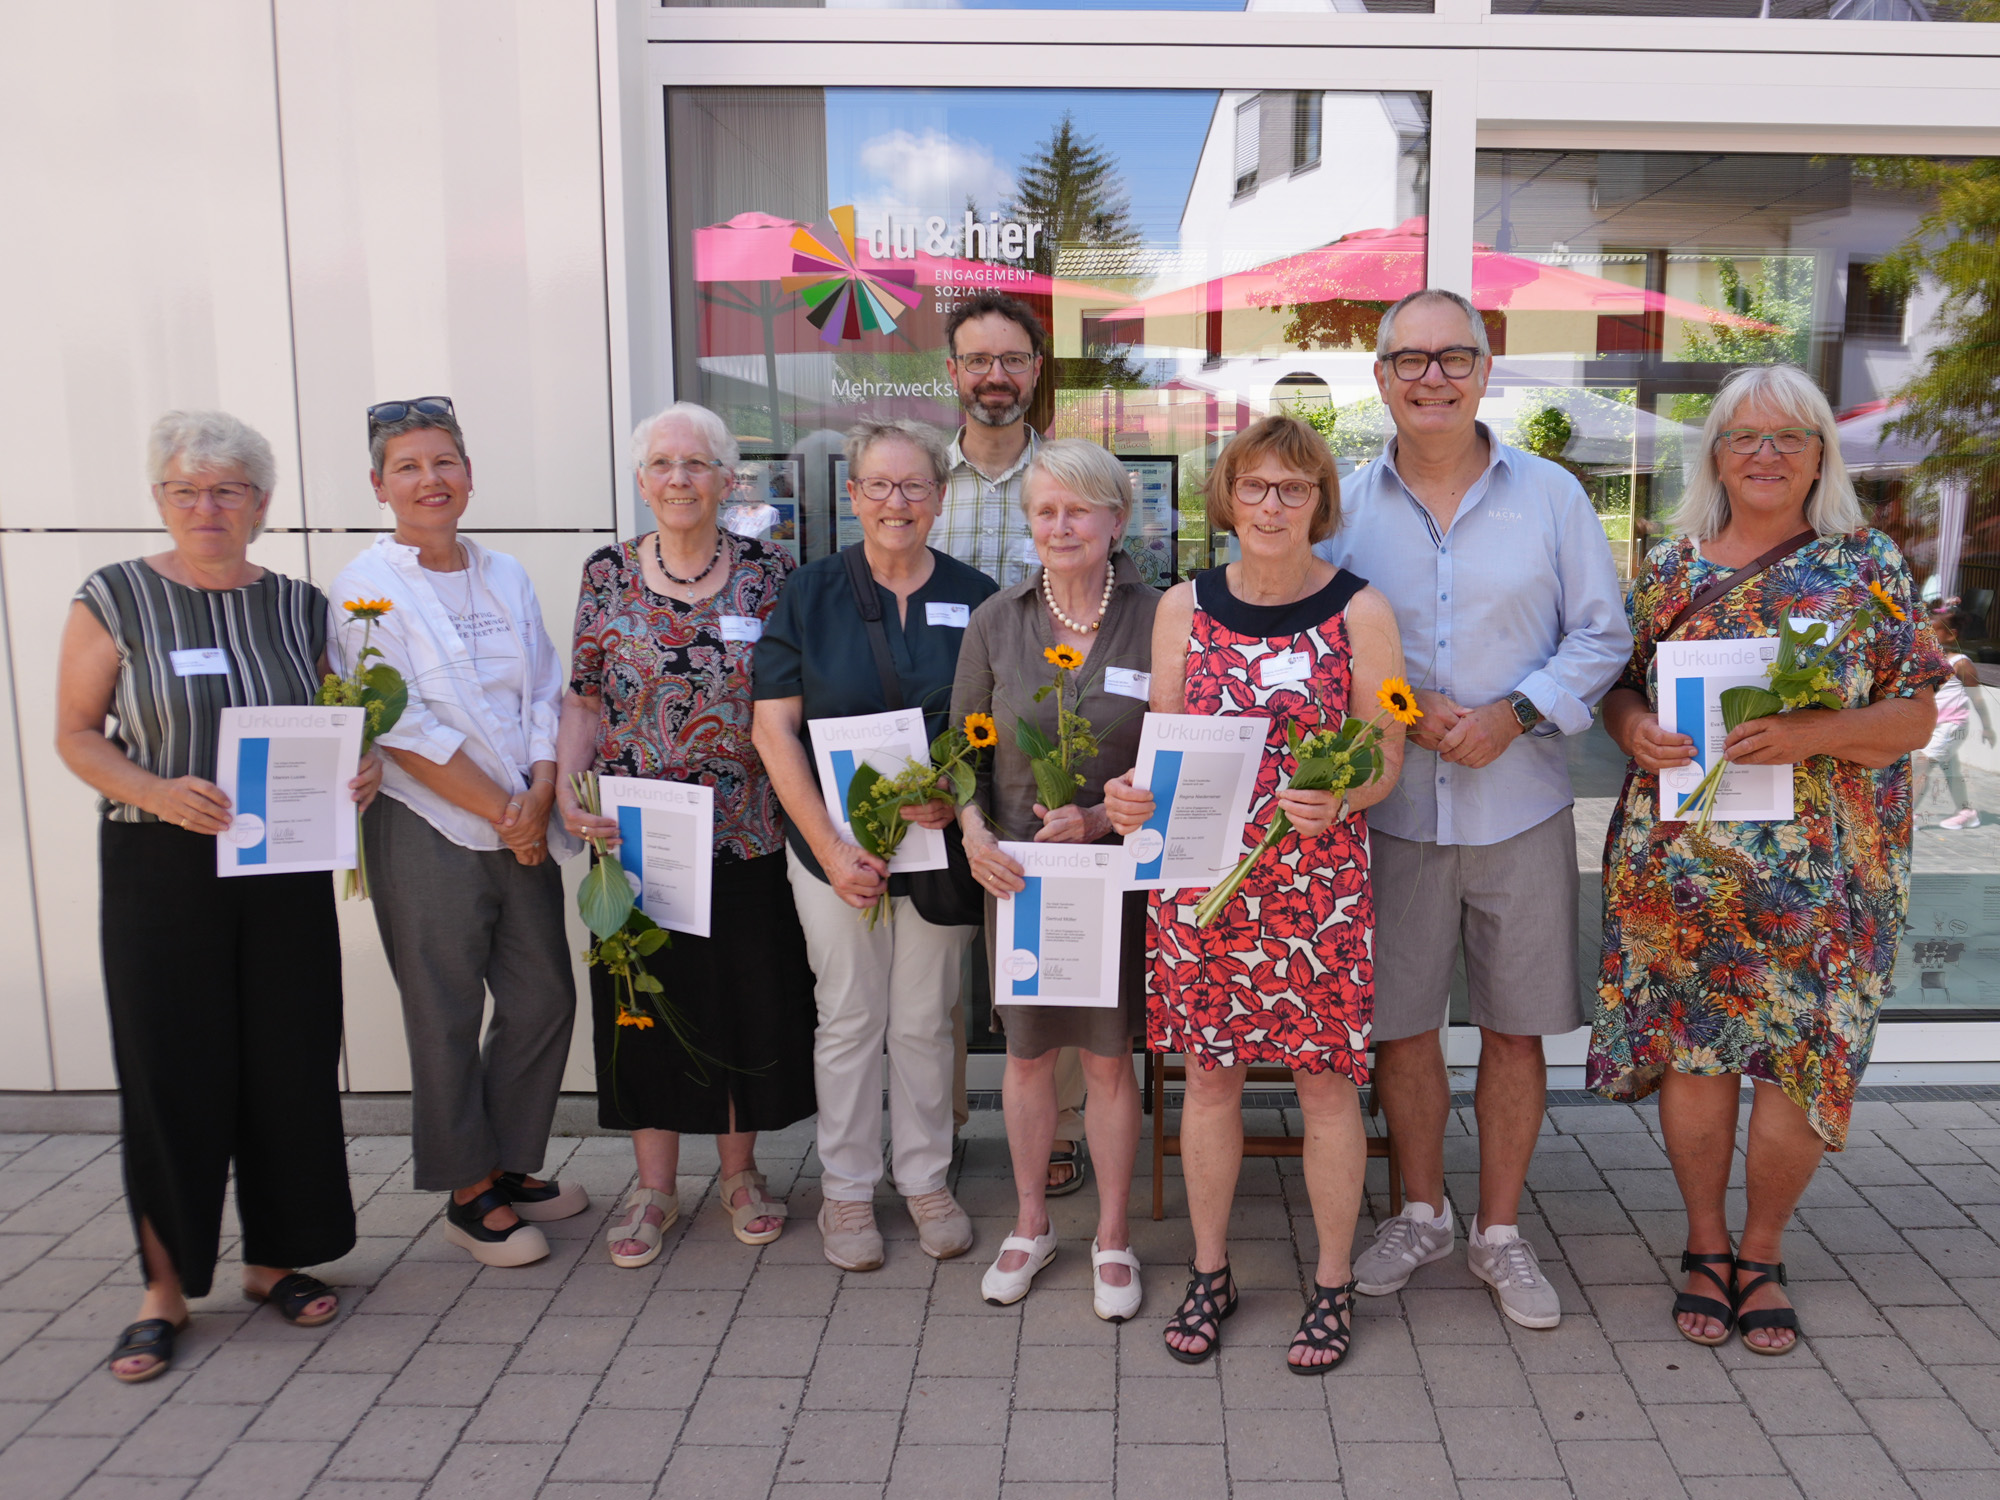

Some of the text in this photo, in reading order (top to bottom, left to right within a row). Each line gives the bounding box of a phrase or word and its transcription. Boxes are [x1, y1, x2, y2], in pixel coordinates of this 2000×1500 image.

[868, 210, 1042, 260] du & hier
[935, 269, 1035, 281] ENGAGEMENT
[1672, 648, 1756, 667] Urkunde
[237, 714, 326, 729] Urkunde
[822, 722, 893, 742] Urkunde
[1157, 722, 1235, 742] Urkunde
[613, 783, 684, 804] Urkunde
